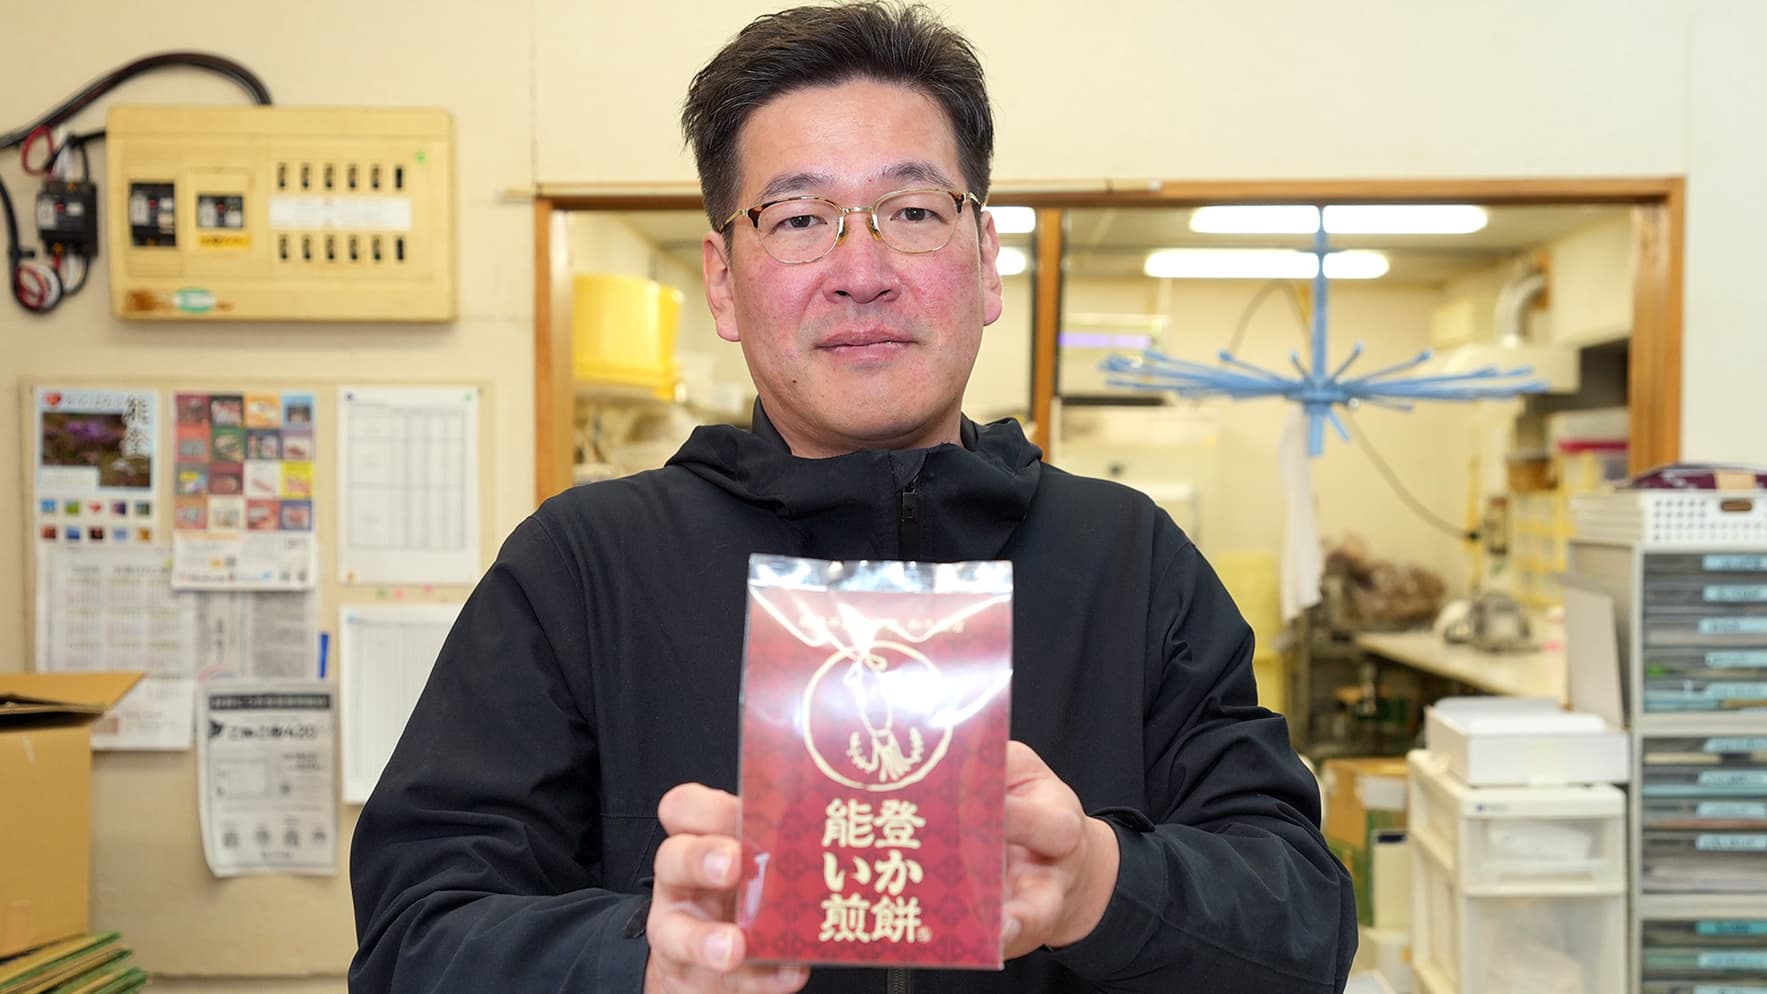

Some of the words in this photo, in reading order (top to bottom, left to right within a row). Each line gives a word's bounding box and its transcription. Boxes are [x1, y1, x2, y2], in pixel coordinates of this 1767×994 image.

[821, 798, 926, 849] 能登
[823, 849, 924, 896] いか
[819, 893, 922, 943] 煎餅
